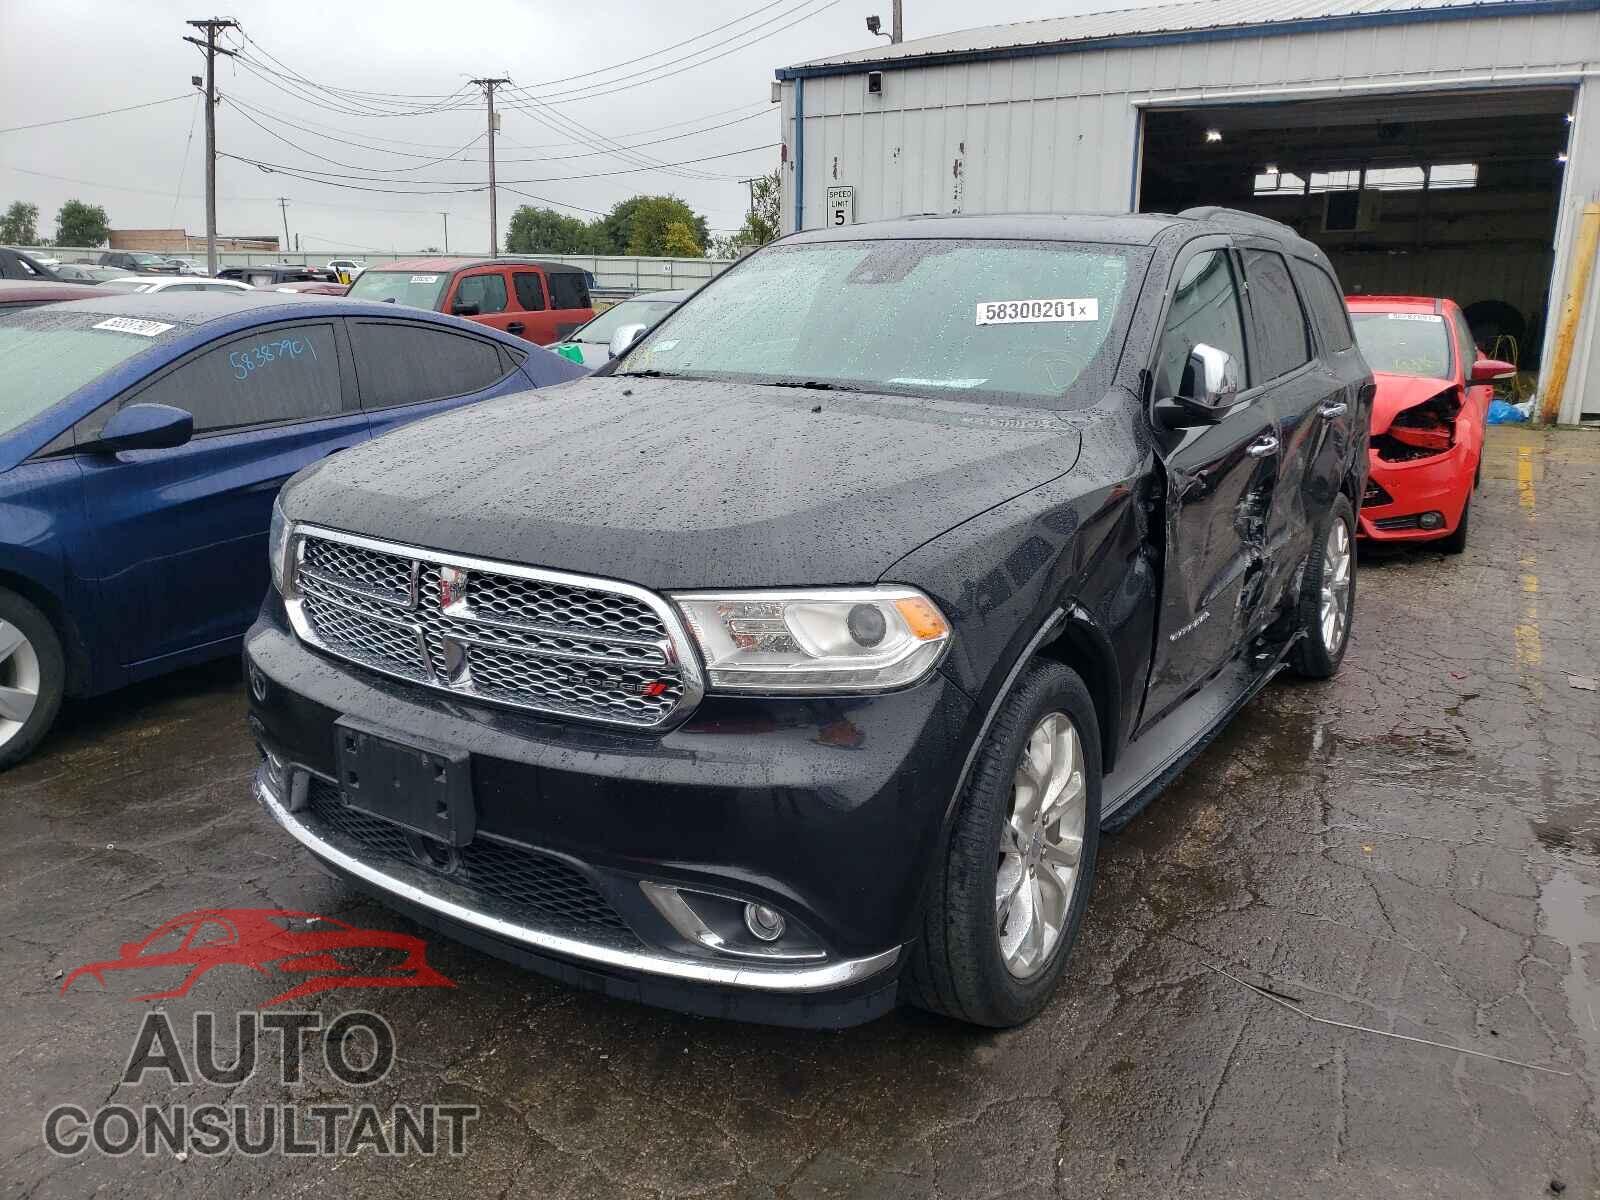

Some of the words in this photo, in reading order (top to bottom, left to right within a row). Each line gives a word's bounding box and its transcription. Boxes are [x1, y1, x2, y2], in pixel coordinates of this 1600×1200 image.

[829, 190, 851, 198] SPEED
[831, 200, 848, 208] LIMIT
[835, 210, 845, 226] 5
